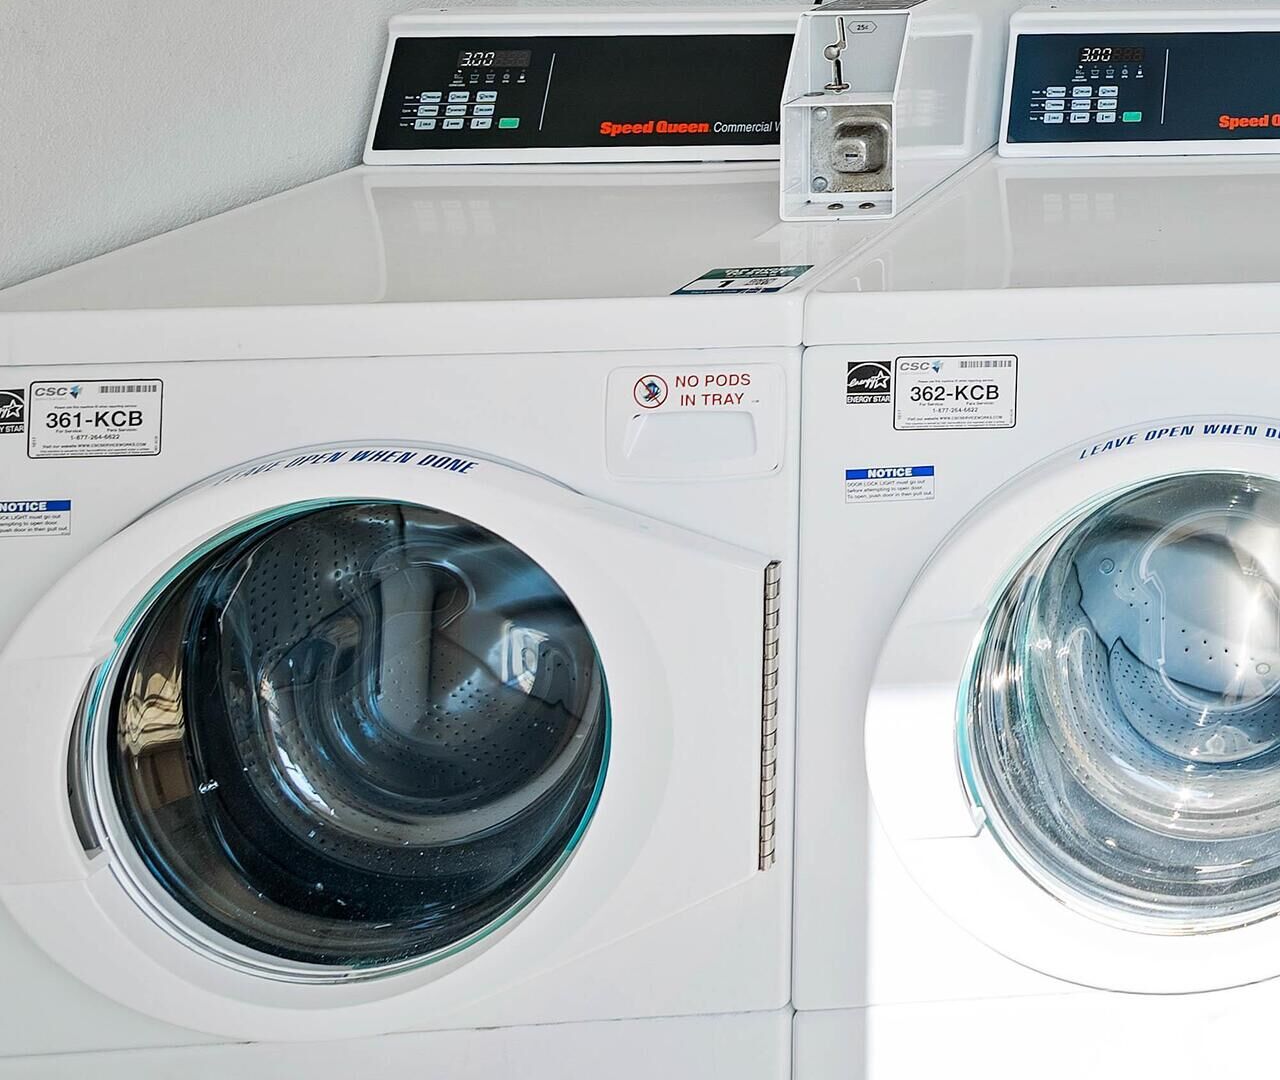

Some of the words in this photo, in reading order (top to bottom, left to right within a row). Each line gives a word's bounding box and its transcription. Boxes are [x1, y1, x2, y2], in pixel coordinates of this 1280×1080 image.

[461, 52, 495, 67] 3.00
[1081, 48, 1112, 62] 3.00
[600, 121, 653, 137] Speed
[656, 120, 710, 134] Queen
[714, 121, 772, 133] Commercial
[1218, 115, 1269, 131] Speed
[900, 362, 930, 371] CSC
[676, 375, 698, 387] NO
[704, 374, 751, 387] PODS
[35, 387, 68, 396] CSC
[910, 385, 999, 401] 362-KCB
[681, 394, 696, 406] IN
[702, 393, 744, 406] TRAY
[847, 395, 872, 403] ENERGY
[873, 395, 890, 403] STAR
[46, 411, 143, 428] 361-KCB
[1080, 433, 1138, 459] LEAVE
[1145, 426, 1195, 441] OPEN
[1203, 424, 1258, 435] WHEN
[284, 451, 349, 469] OPEN
[350, 450, 417, 463] WHEN
[418, 454, 480, 474] DONE
[868, 468, 913, 478] NOTICE
[0, 502, 47, 512] NOTICE
